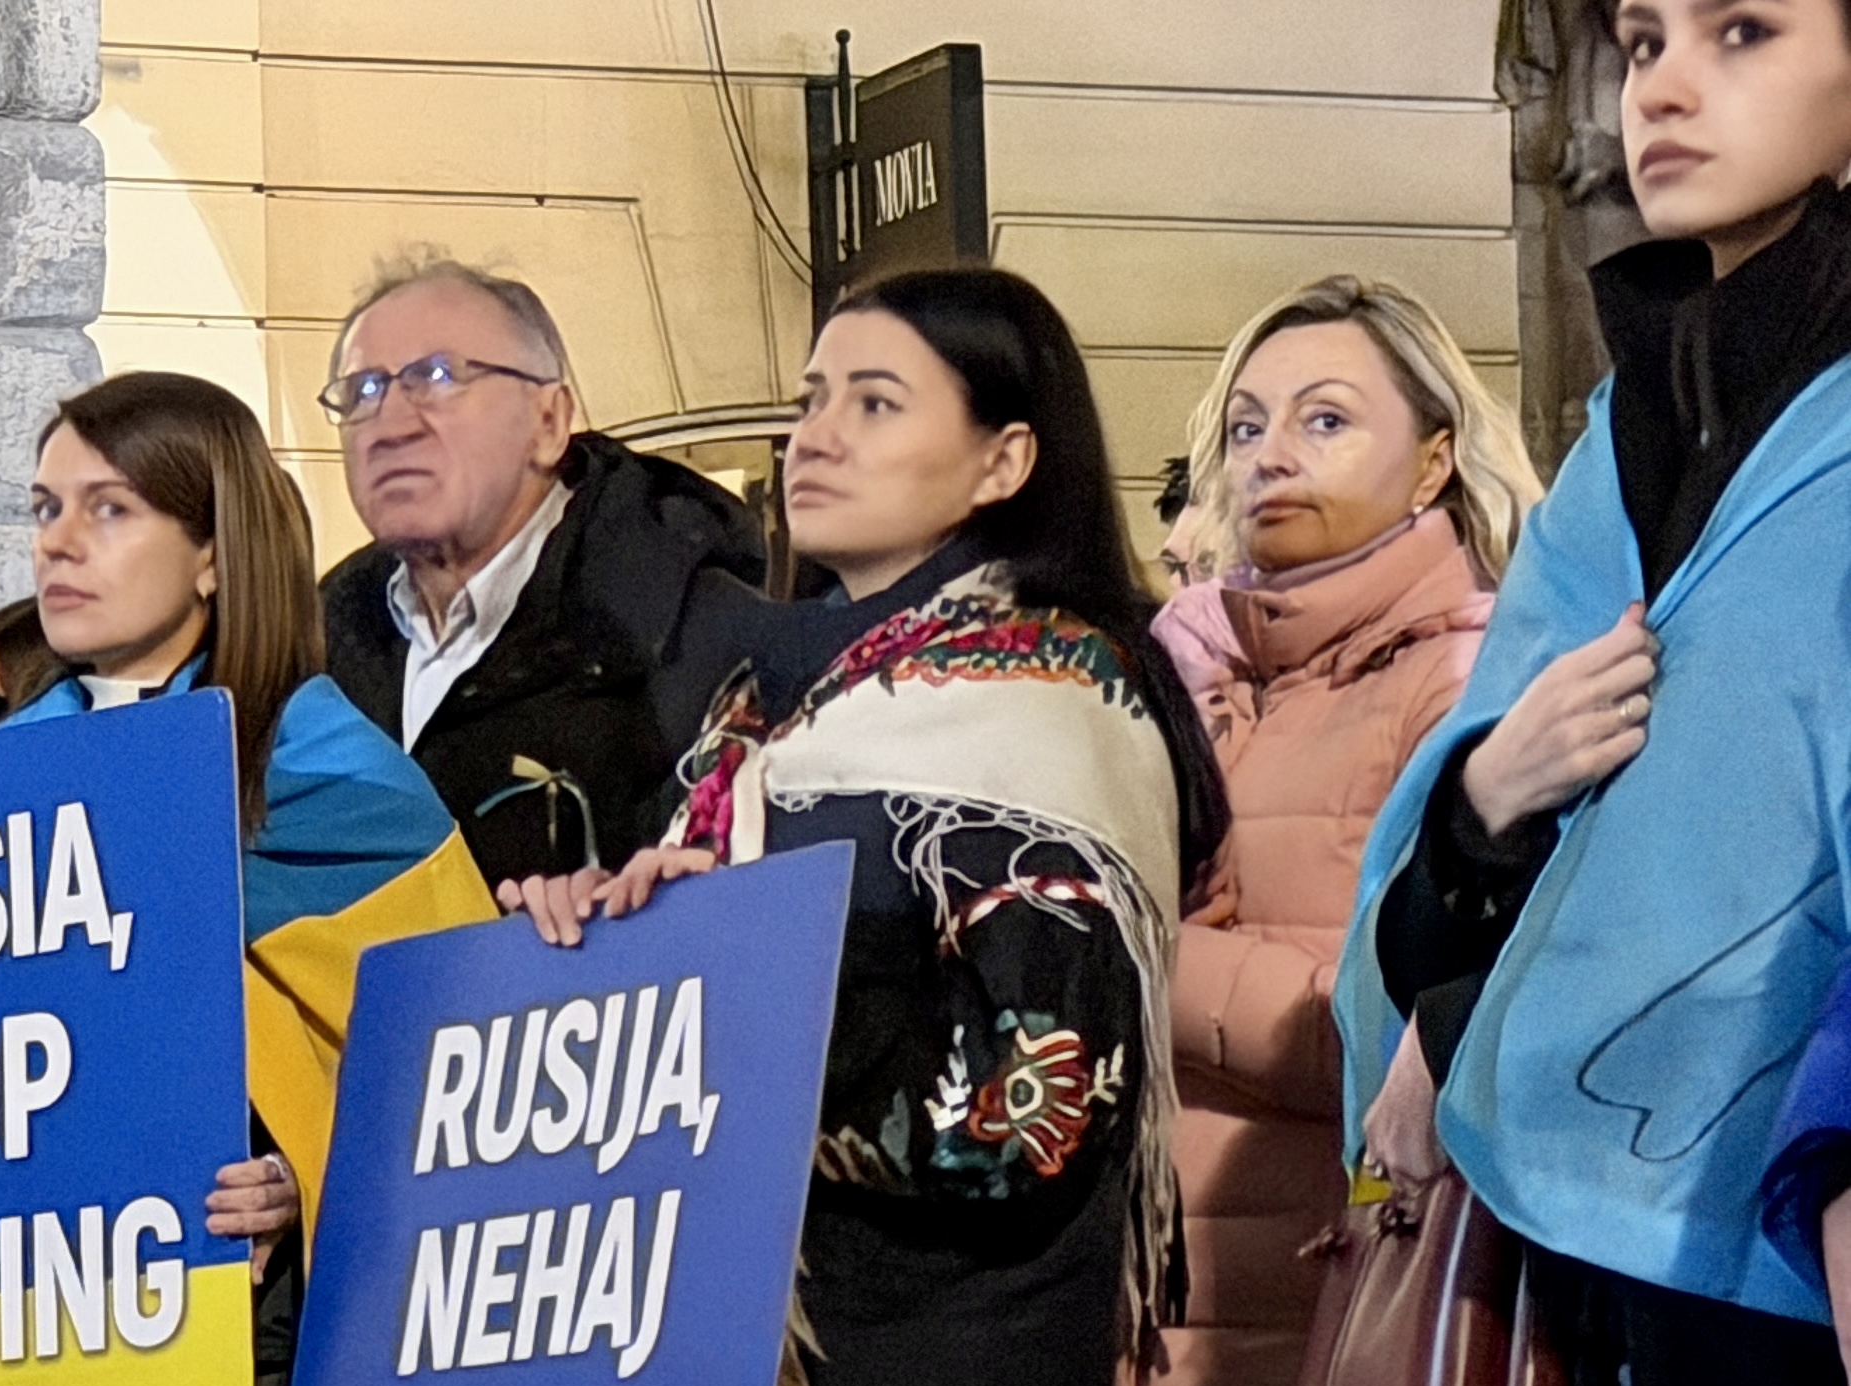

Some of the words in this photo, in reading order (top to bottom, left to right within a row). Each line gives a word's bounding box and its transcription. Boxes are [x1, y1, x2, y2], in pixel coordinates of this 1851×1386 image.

[874, 140, 938, 227] MOVIA
[414, 976, 720, 1174] RUSIJA,
[397, 1189, 682, 1378] NEHAJ
